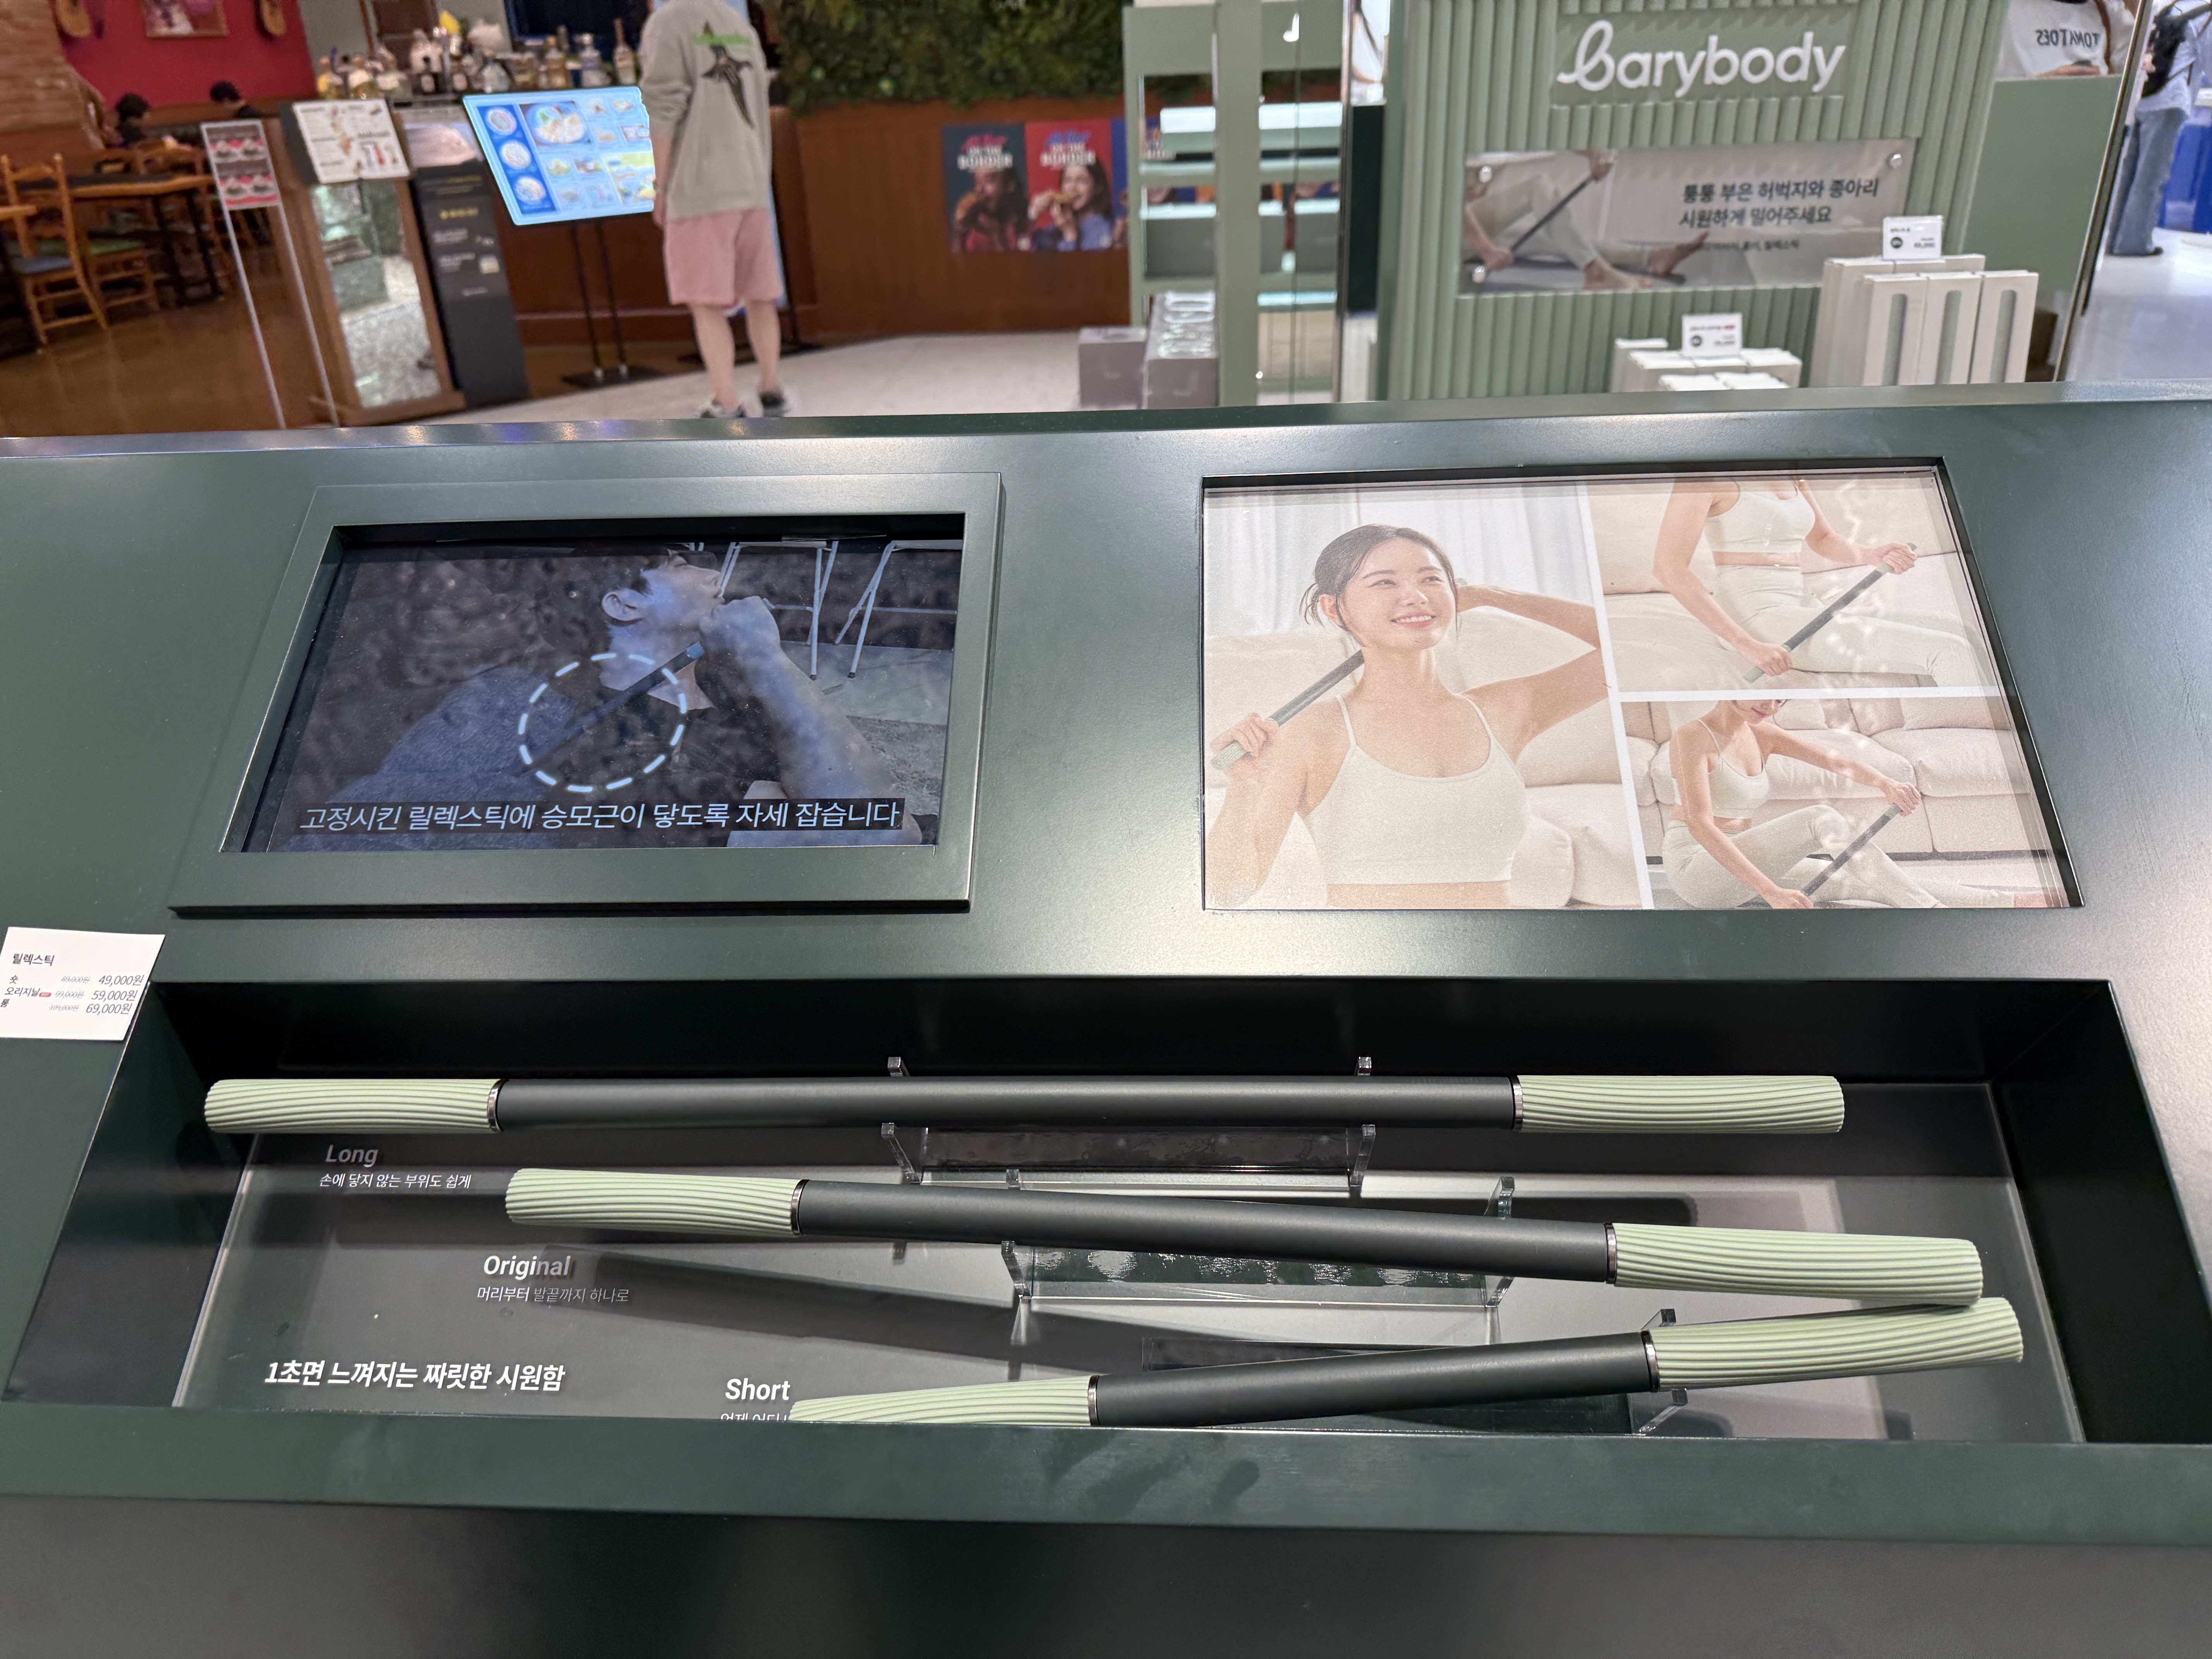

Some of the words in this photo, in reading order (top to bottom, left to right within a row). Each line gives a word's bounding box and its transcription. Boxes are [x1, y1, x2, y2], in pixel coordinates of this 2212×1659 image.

[1721, 182, 1752, 202] 부은
[1758, 179, 1824, 201] 허벅지와
[1829, 177, 1879, 198] 종아리
[1679, 207, 1745, 228] 시원하게
[1750, 206, 1832, 226] 밀어주세요
[300, 806, 402, 831] 고정시킨
[409, 805, 536, 830] 릴렉스틱에
[542, 804, 645, 829] 승모근이
[654, 803, 730, 828] 닿도록
[736, 802, 789, 828] 자세
[795, 802, 900, 828] 잡습니다
[12, 953, 55, 966] 릴렉스틱
[98, 974, 145, 987] 49,000원
[91, 989, 138, 1002] 59,000원
[86, 1002, 133, 1015] 69,000원
[326, 1144, 378, 1168] Long
[319, 1173, 346, 1187] 손에
[349, 1173, 374, 1187] 닿지
[376, 1174, 402, 1188] 않는
[404, 1174, 442, 1188] 부위도
[446, 1174, 472, 1189] 쉽게
[483, 1255, 572, 1280] Original
[477, 1286, 530, 1302] 머리부터
[534, 1287, 586, 1303] 발끝까지
[590, 1287, 630, 1303] 하나로
[264, 1360, 325, 1386] 1초면
[327, 1361, 418, 1388] 느껴지는
[422, 1362, 492, 1390] 짜릿한
[495, 1364, 566, 1391] 시원함
[725, 1377, 791, 1400] Short
